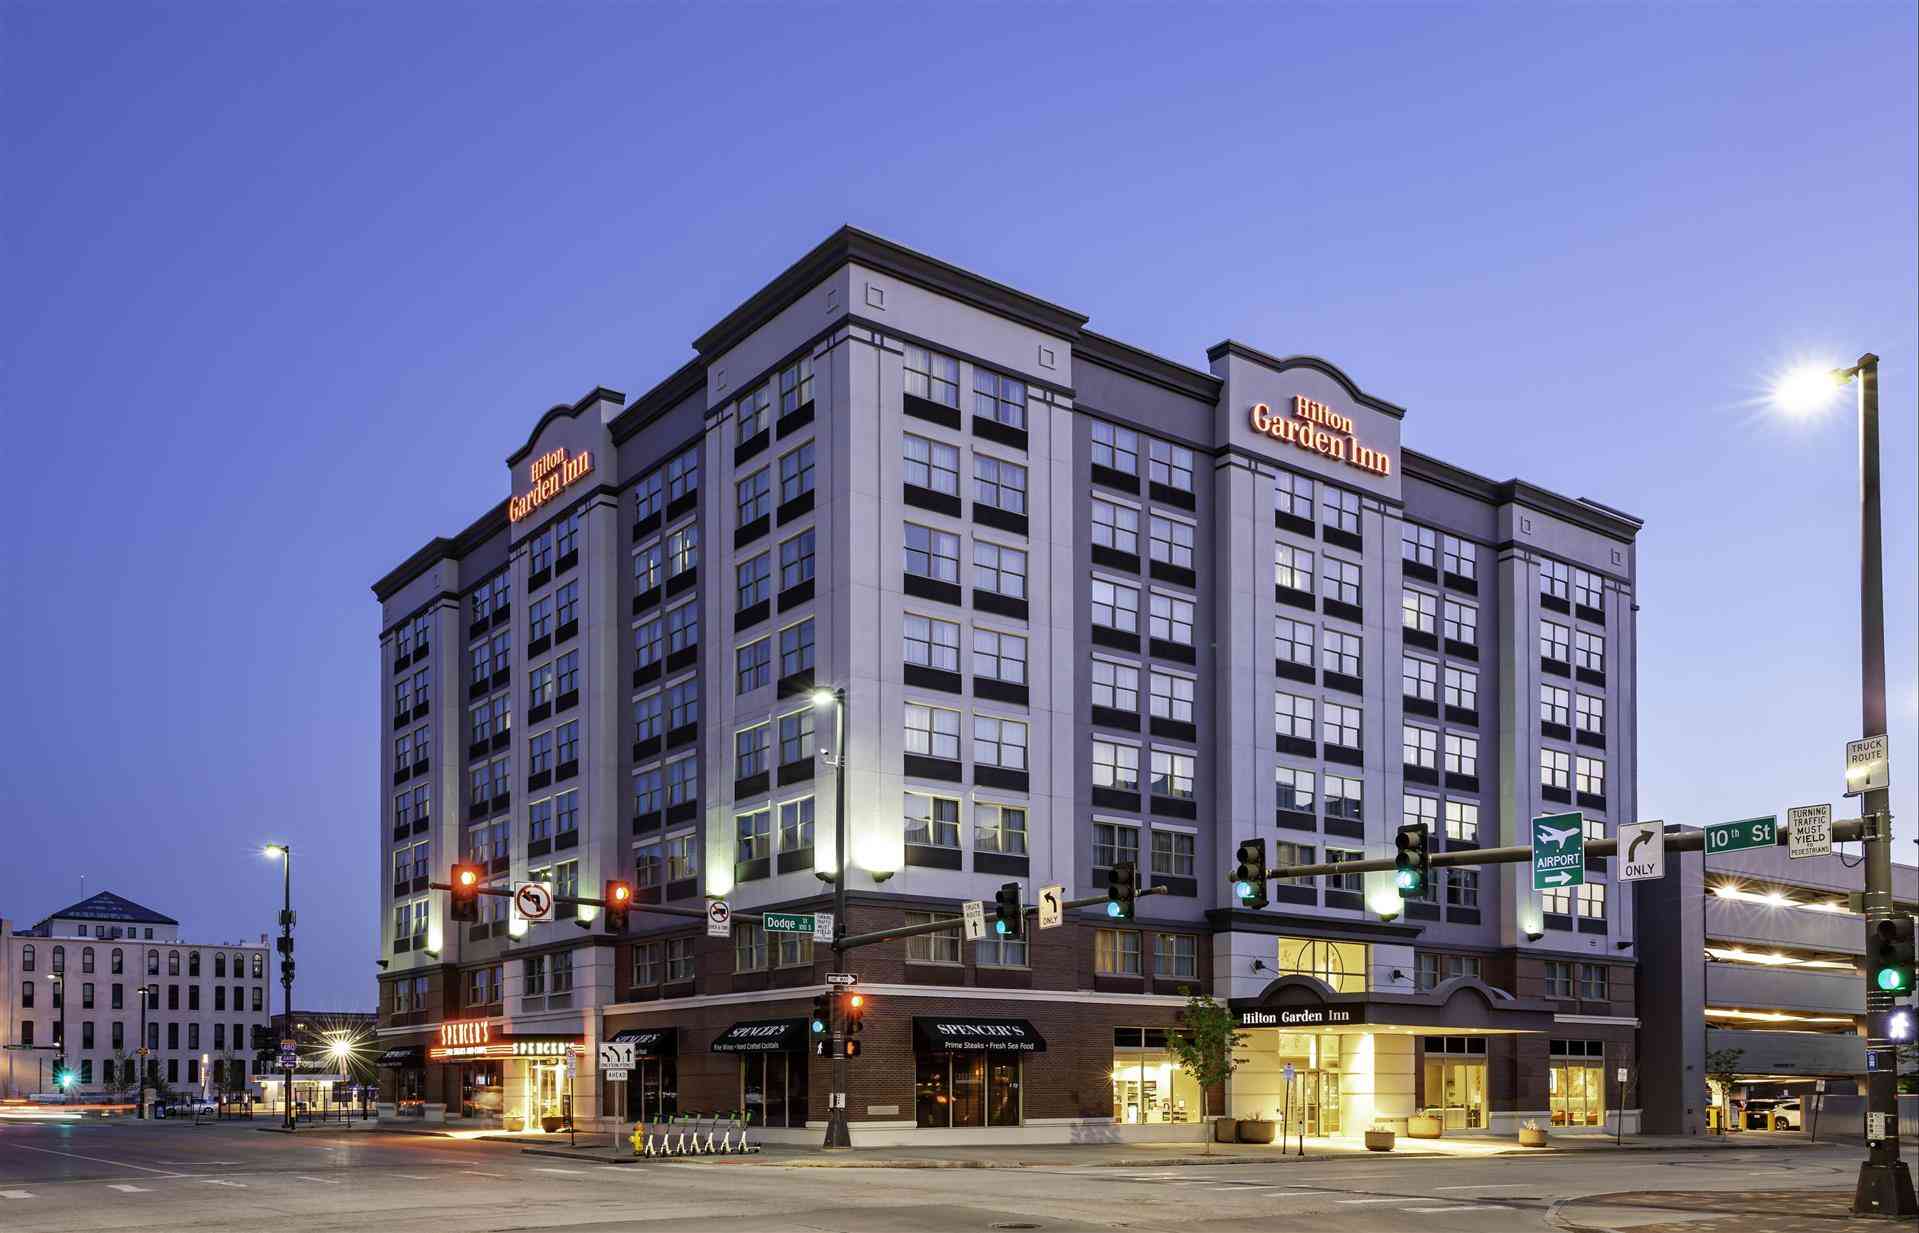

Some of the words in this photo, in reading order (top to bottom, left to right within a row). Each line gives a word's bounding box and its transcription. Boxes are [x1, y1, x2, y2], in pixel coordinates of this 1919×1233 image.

[1296, 395, 1353, 433] Hilton
[1254, 404, 1345, 459] Garden
[1347, 436, 1390, 475] Inn
[531, 448, 565, 482] Hilton
[510, 473, 560, 522] Garden
[562, 451, 589, 486] Inn
[1851, 738, 1882, 752] TRUCK
[1852, 751, 1882, 763] ROUTE
[1793, 807, 1826, 818] TURNING
[1794, 816, 1826, 826] TRAFFIC
[1752, 824, 1771, 842] St
[1797, 825, 1822, 835] MUST
[1795, 834, 1825, 844] YIELD
[1537, 853, 1580, 868] AIRPORT
[1626, 864, 1655, 876] ONLY
[767, 917, 796, 930] Dodge
[1043, 916, 1058, 925] ONLY
[1243, 1012, 1276, 1024] Hilton
[1281, 1010, 1322, 1022] Garden
[1328, 1010, 1349, 1020] Inn
[441, 1021, 488, 1045] SPENCER'S
[937, 1023, 1025, 1036] SPENCER'S
[1008, 1042, 1019, 1050] Sea
